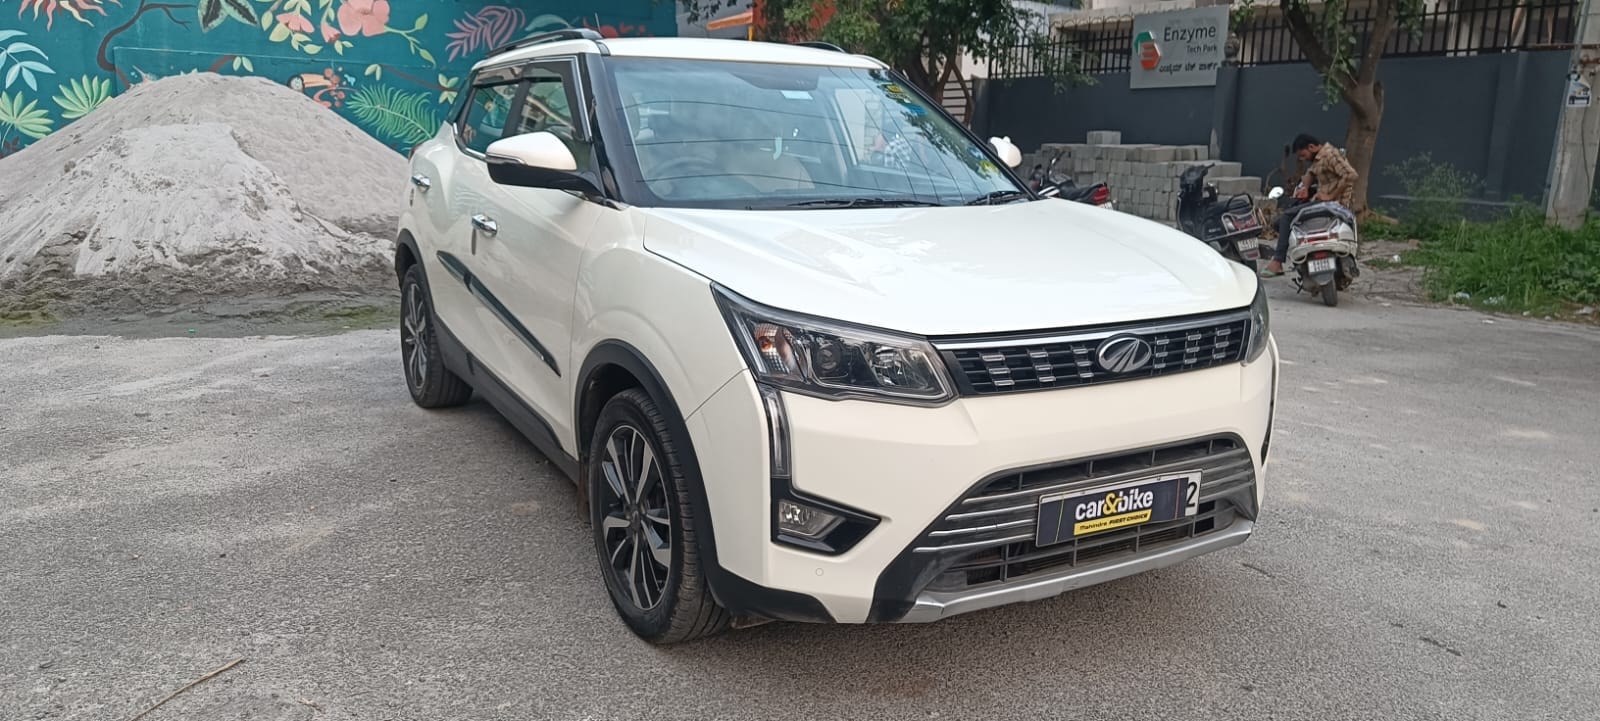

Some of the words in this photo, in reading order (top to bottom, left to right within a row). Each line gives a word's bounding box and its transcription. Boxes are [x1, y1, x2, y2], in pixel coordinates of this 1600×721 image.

[1164, 26, 1216, 43] Enzyme
[1186, 44, 1201, 54] Tech
[1203, 43, 1217, 53] Park
[1186, 481, 1198, 508] 2
[1080, 521, 1107, 531] Mahindra
[1109, 517, 1126, 525] FIRST
[1127, 513, 1149, 522] CHOICE
